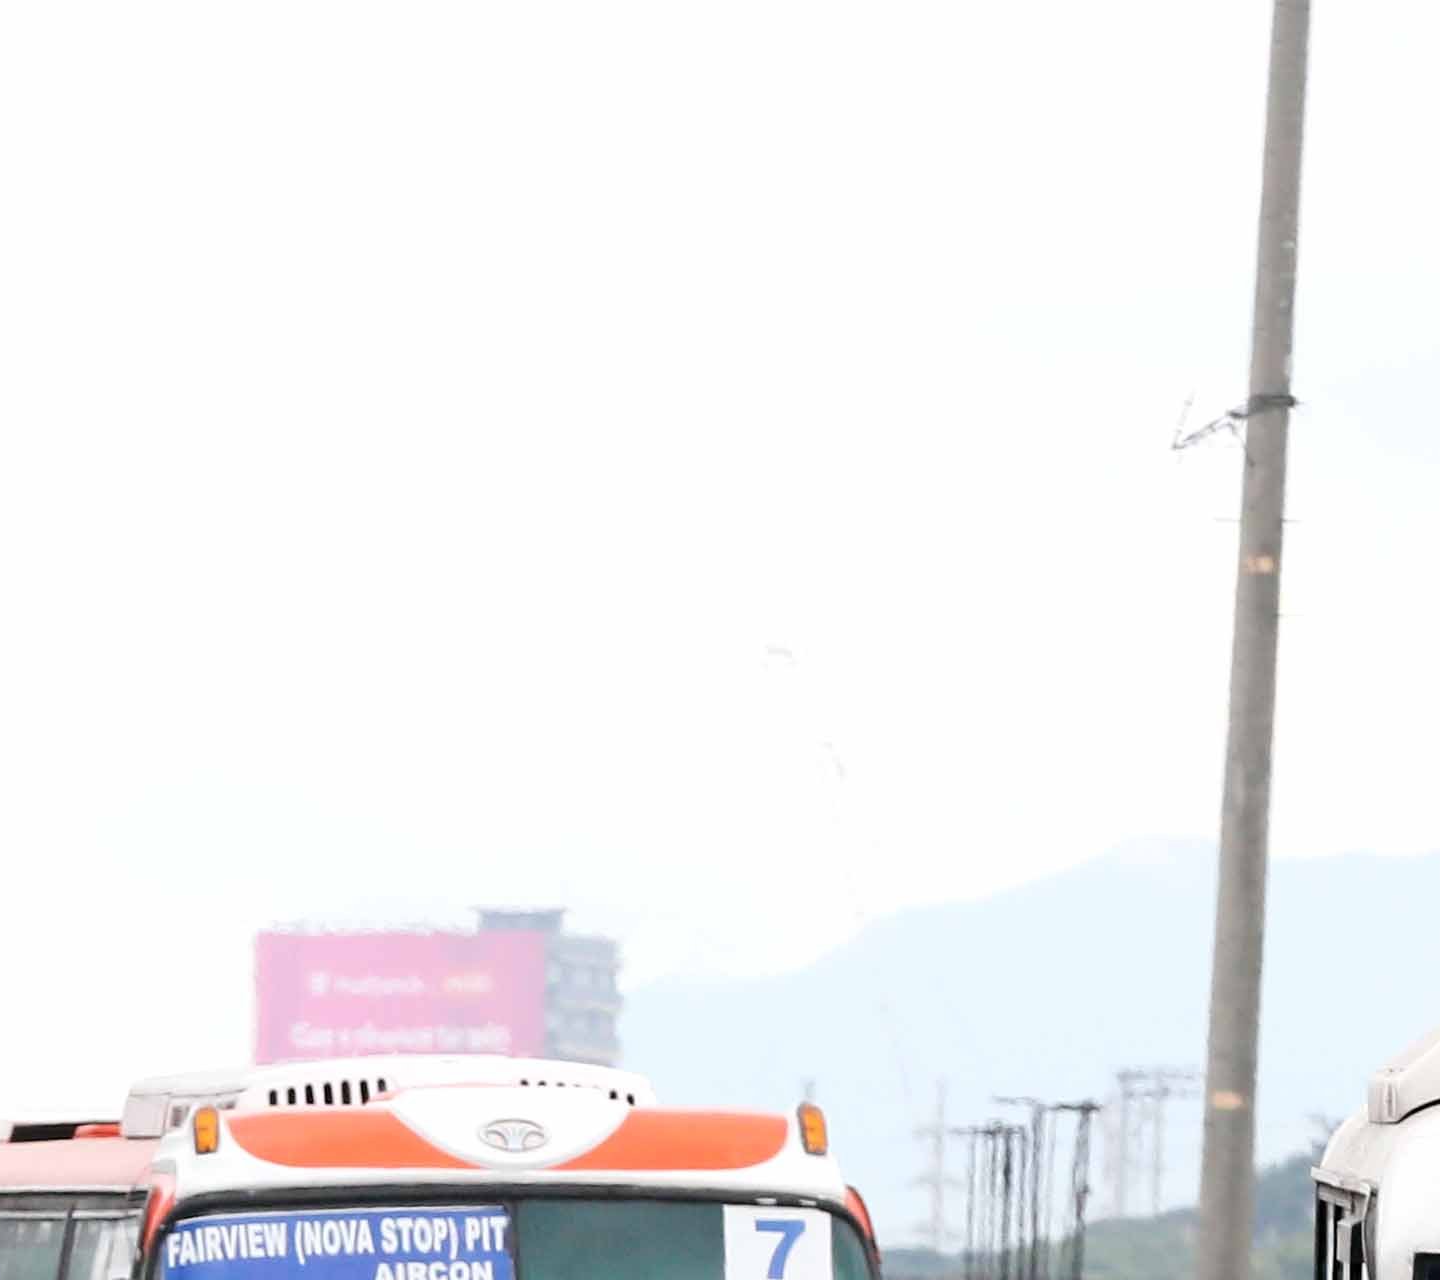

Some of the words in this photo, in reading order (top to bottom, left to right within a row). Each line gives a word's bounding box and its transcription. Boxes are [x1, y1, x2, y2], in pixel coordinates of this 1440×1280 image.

[167, 1222, 288, 1267] FAIRVIEW
[295, 1218, 375, 1265] (NOVA
[380, 1216, 458, 1260] STOP)
[754, 1218, 807, 1280] 7
